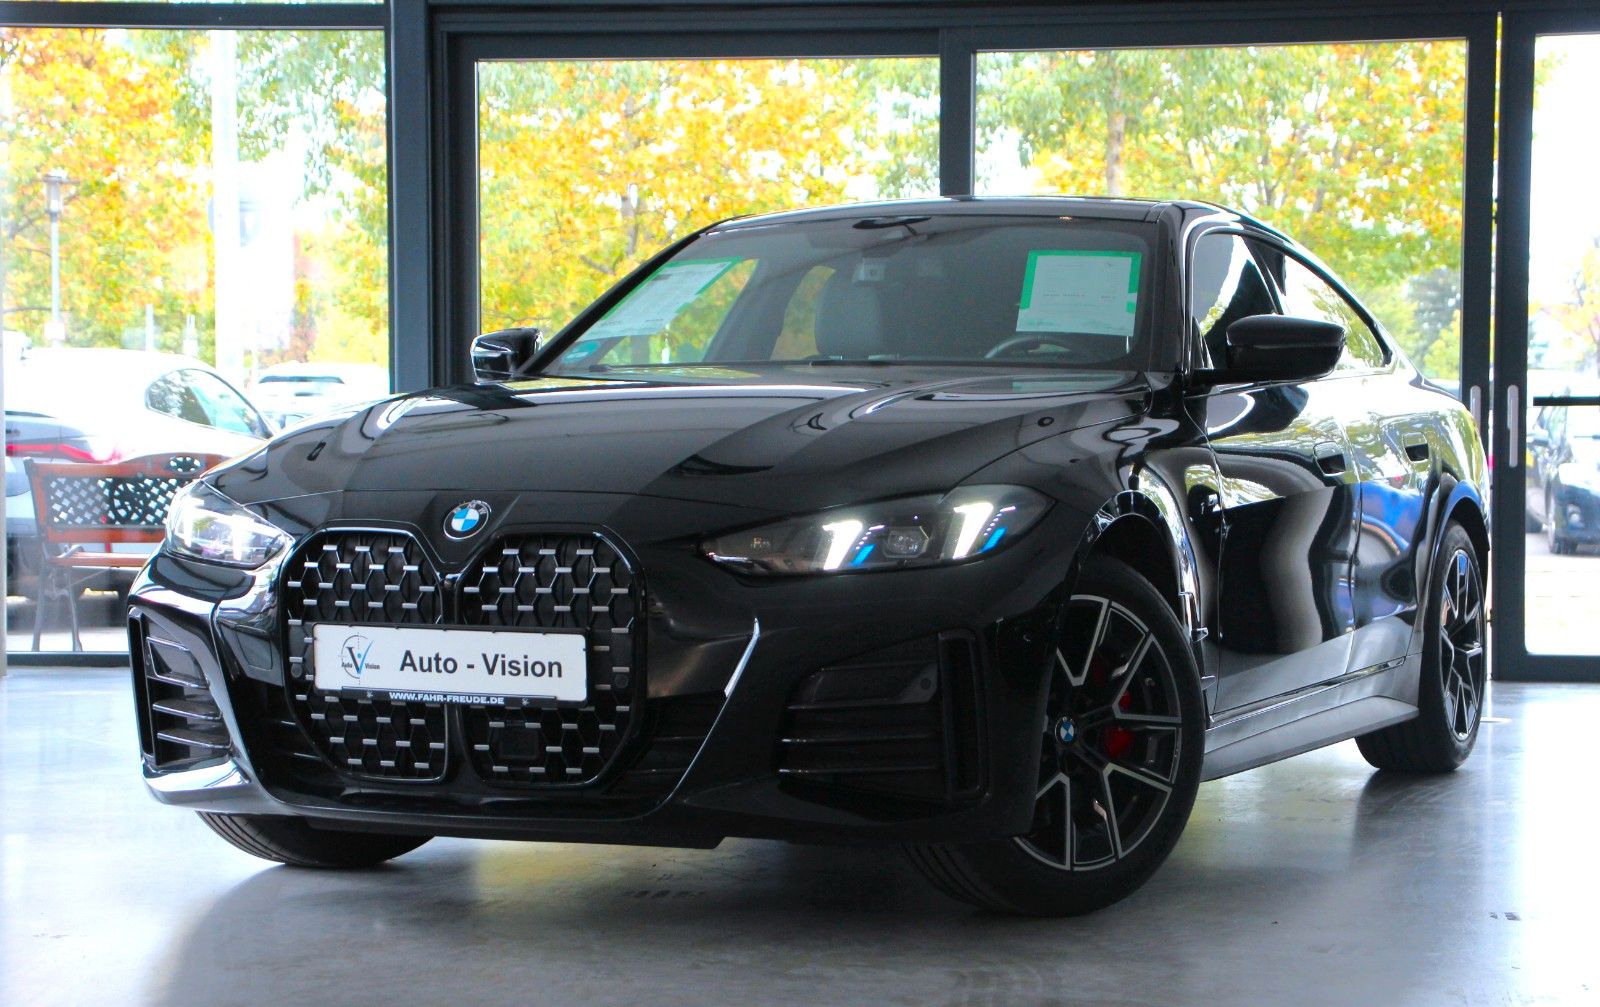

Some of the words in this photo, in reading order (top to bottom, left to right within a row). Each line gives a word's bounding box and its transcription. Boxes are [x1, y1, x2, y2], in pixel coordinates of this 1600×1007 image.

[400, 650, 458, 674] Auto
[482, 653, 562, 678] Vision
[389, 691, 504, 705] WWW.FAHR-FREUDE.DE
